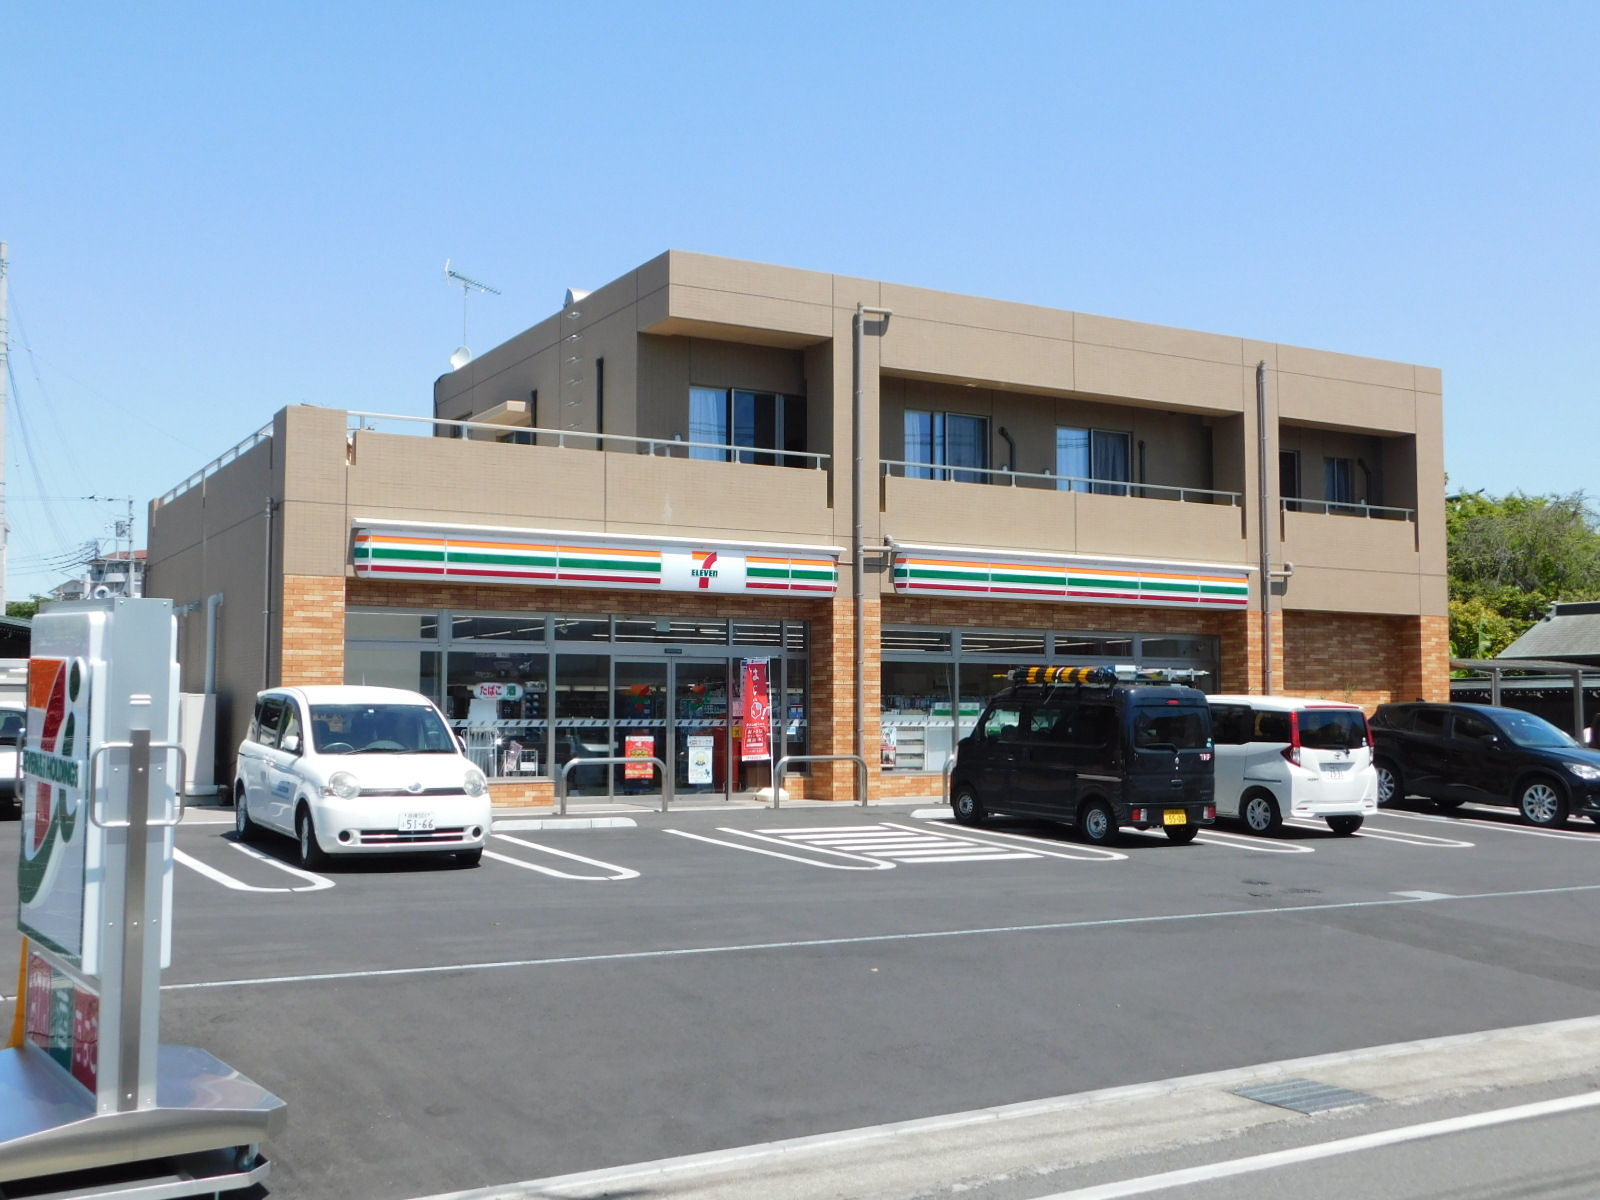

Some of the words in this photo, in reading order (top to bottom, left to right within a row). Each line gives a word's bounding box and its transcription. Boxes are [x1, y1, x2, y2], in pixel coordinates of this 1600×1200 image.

[479, 685, 503, 697] たばこ
[407, 819, 434, 829] 51-66
